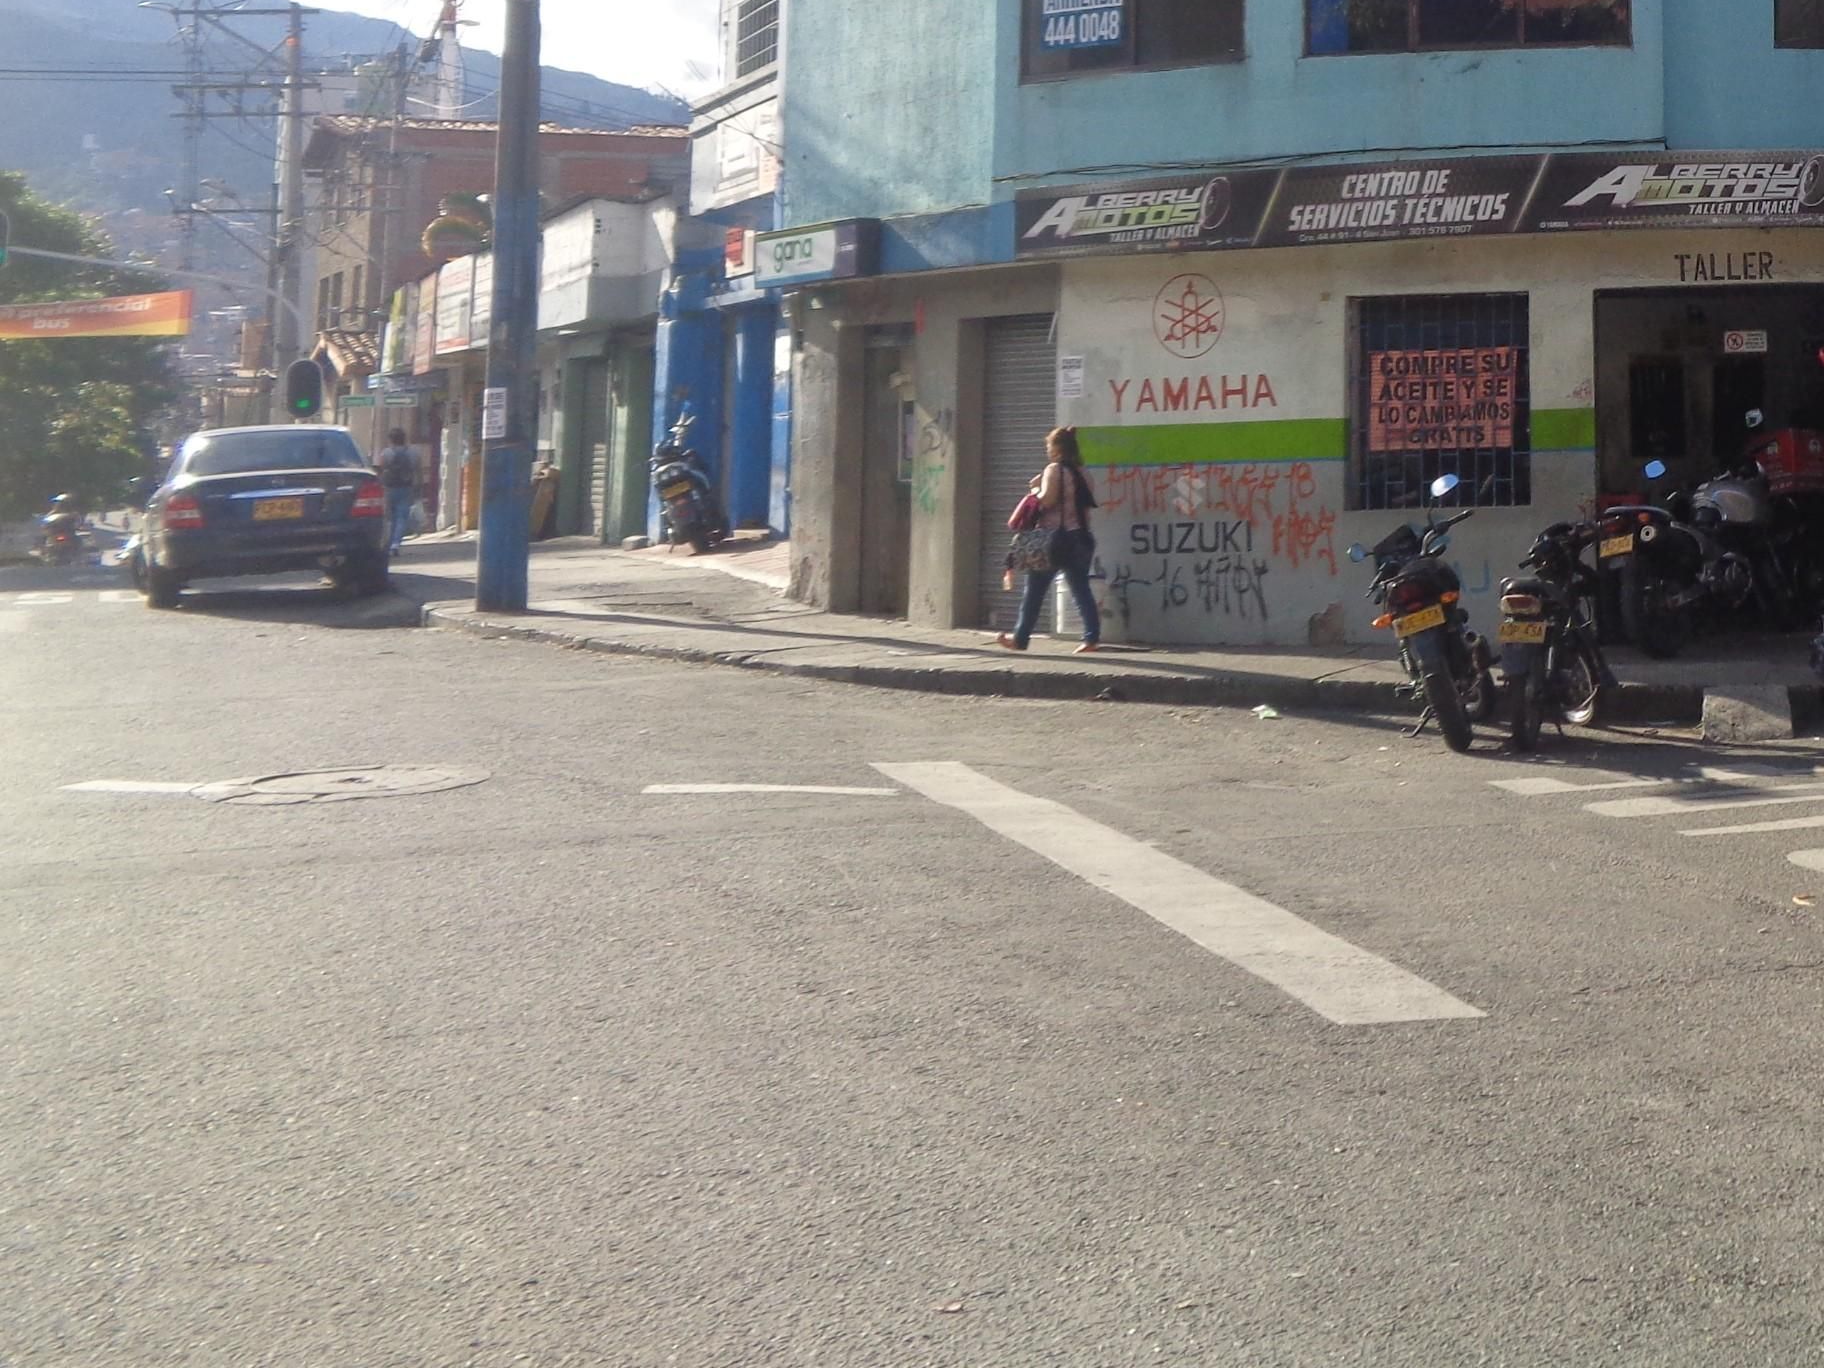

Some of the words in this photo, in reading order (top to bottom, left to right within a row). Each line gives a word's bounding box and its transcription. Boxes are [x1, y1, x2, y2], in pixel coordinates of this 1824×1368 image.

[1044, 15, 1075, 45] 444
[1079, 10, 1119, 43] 0048
[1341, 170, 1422, 199] CENTRO
[1422, 169, 1452, 194] DE
[1288, 199, 1399, 232] SERVICIOS
[1402, 192, 1511, 226] TÉCNICOS
[1688, 203, 1734, 215] TALLER
[1735, 202, 1744, 214] Y
[1110, 229, 1146, 243] TALLER
[1409, 226, 1427, 236] 301
[773, 237, 812, 273] gana
[1674, 251, 1773, 282] TALLER
[32, 317, 71, 329] bus
[1379, 355, 1474, 376] COMPRE
[1481, 353, 1511, 372] SU
[1109, 373, 1277, 413] YAMAHA
[1379, 380, 1455, 401] ACEITE
[1460, 380, 1473, 399] Y
[1482, 378, 1507, 397] SE
[1378, 406, 1400, 424] LO
[1406, 401, 1510, 423] CAMBIAMOS
[1409, 426, 1484, 444] GRATIS
[1131, 520, 1254, 555] SUZUKI
